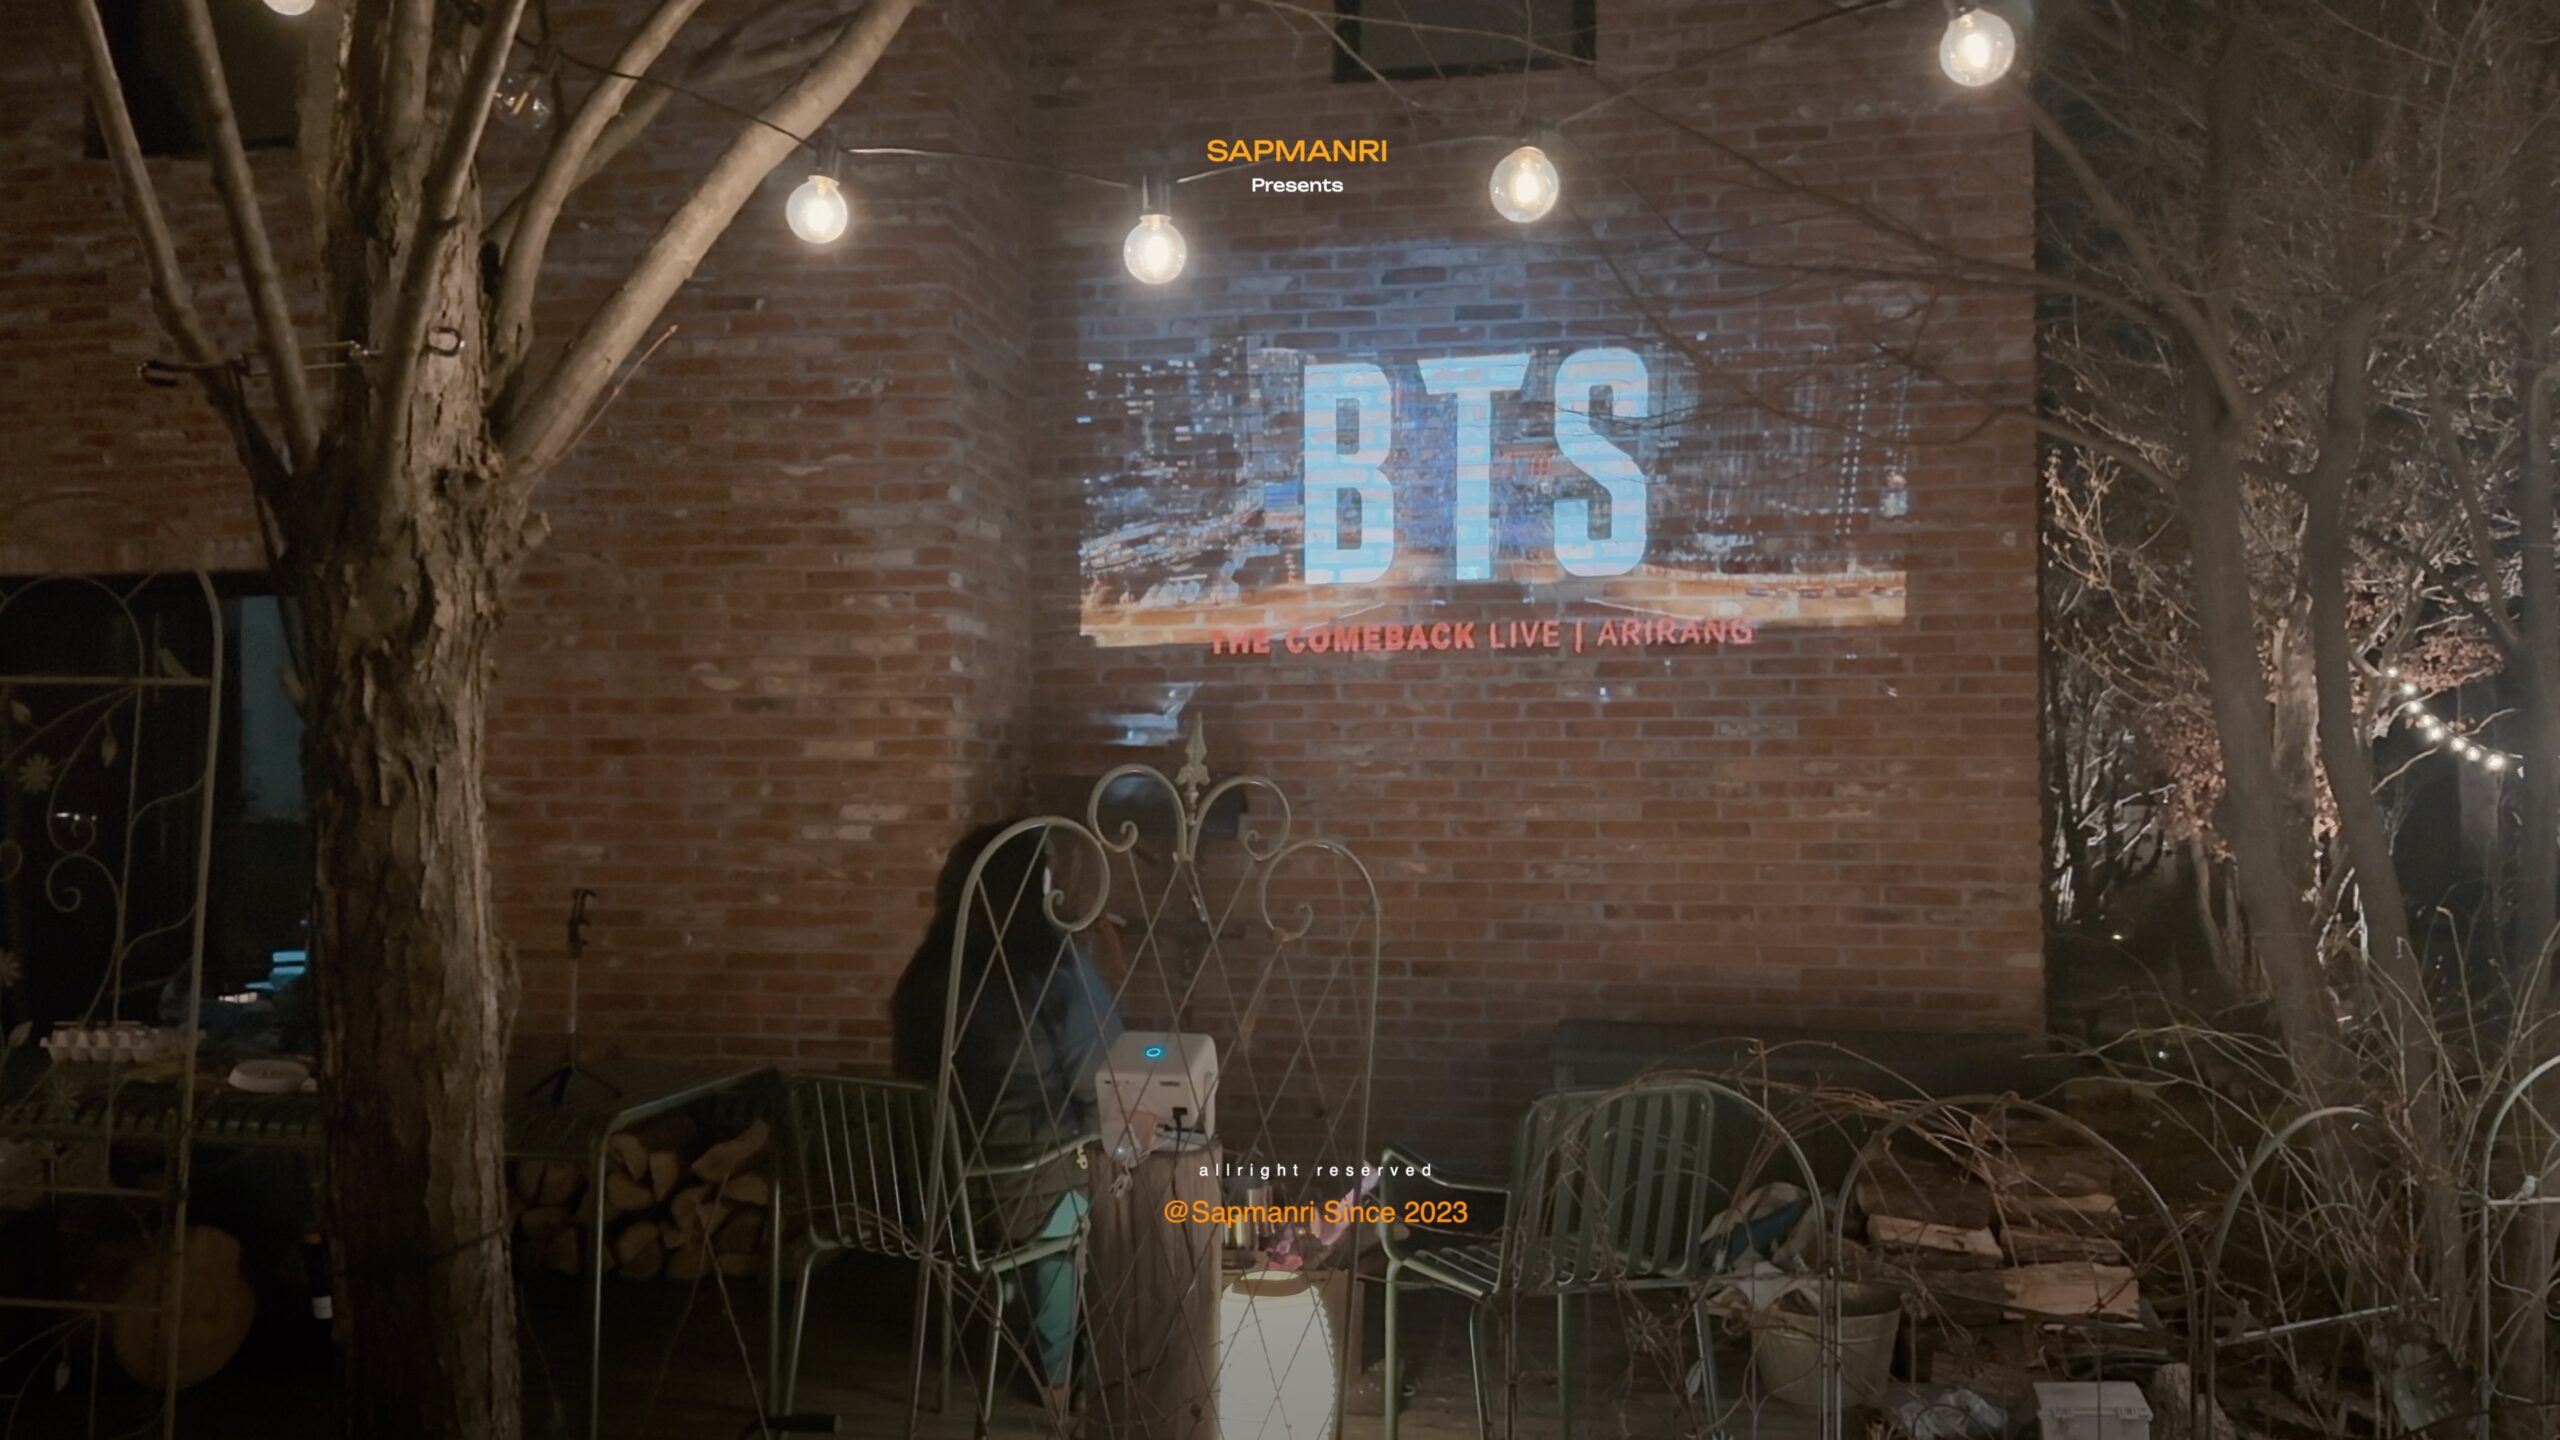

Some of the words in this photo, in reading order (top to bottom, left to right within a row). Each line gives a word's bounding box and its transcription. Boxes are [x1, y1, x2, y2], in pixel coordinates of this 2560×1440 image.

[1304, 347, 1649, 585] BTS
[1209, 628, 1271, 654] THE
[1285, 621, 1475, 654] COMEBACK
[1490, 620, 1560, 649] LIVE
[1597, 616, 1753, 646] ARIRANG
